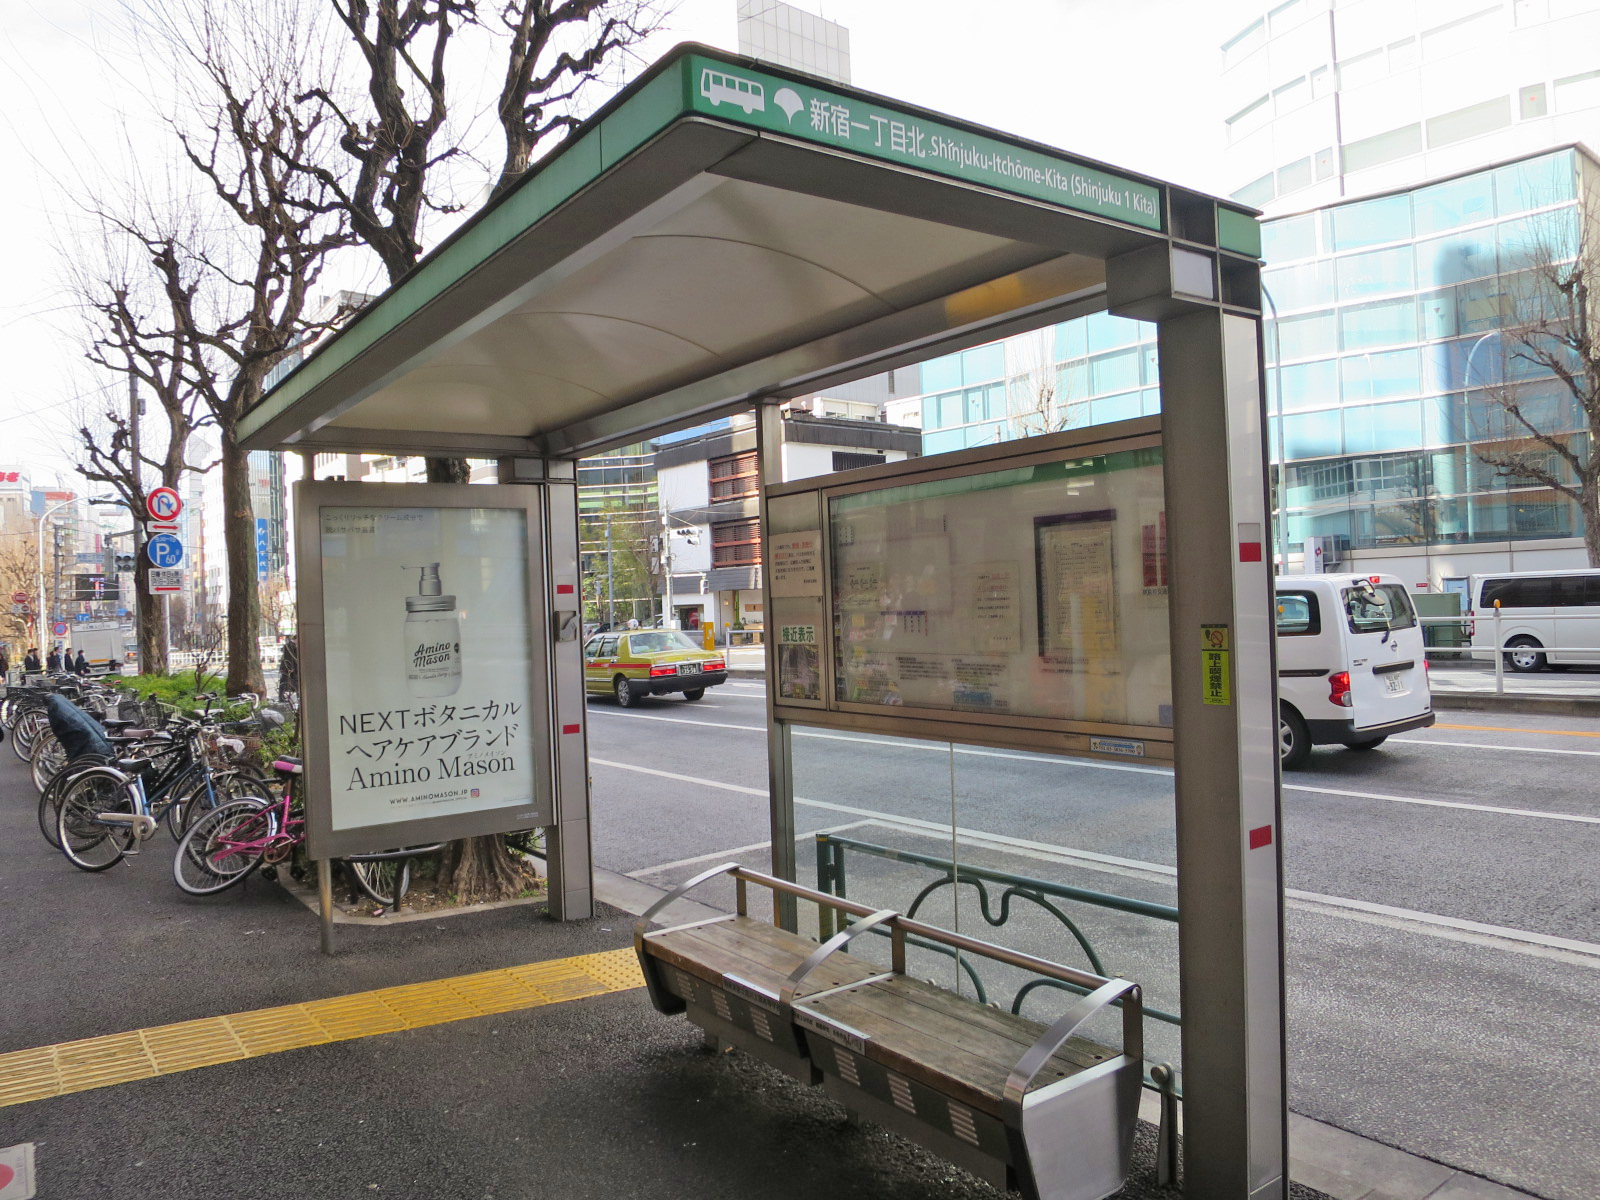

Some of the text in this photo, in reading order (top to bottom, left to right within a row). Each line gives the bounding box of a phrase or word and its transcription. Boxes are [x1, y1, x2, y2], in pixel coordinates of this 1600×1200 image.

[810, 98, 925, 158] 新宿一丁目北
[931, 135, 1157, 219] Shinjuku-Itchōme-Kita (Shinjuku 1 Kita)
[414, 643, 450, 656] Amino
[783, 626, 814, 643] 接近表示
[413, 653, 450, 667] Mason
[1208, 653, 1222, 697] 路上喫煙禁止
[340, 700, 522, 735] NEXTボタニカル
[346, 723, 519, 761] ヘアケアブランド
[467, 750, 506, 760] アミノメイソン
[346, 754, 516, 791] Amino Mason
[390, 789, 468, 805] WWW.AMINOMASON.JP
